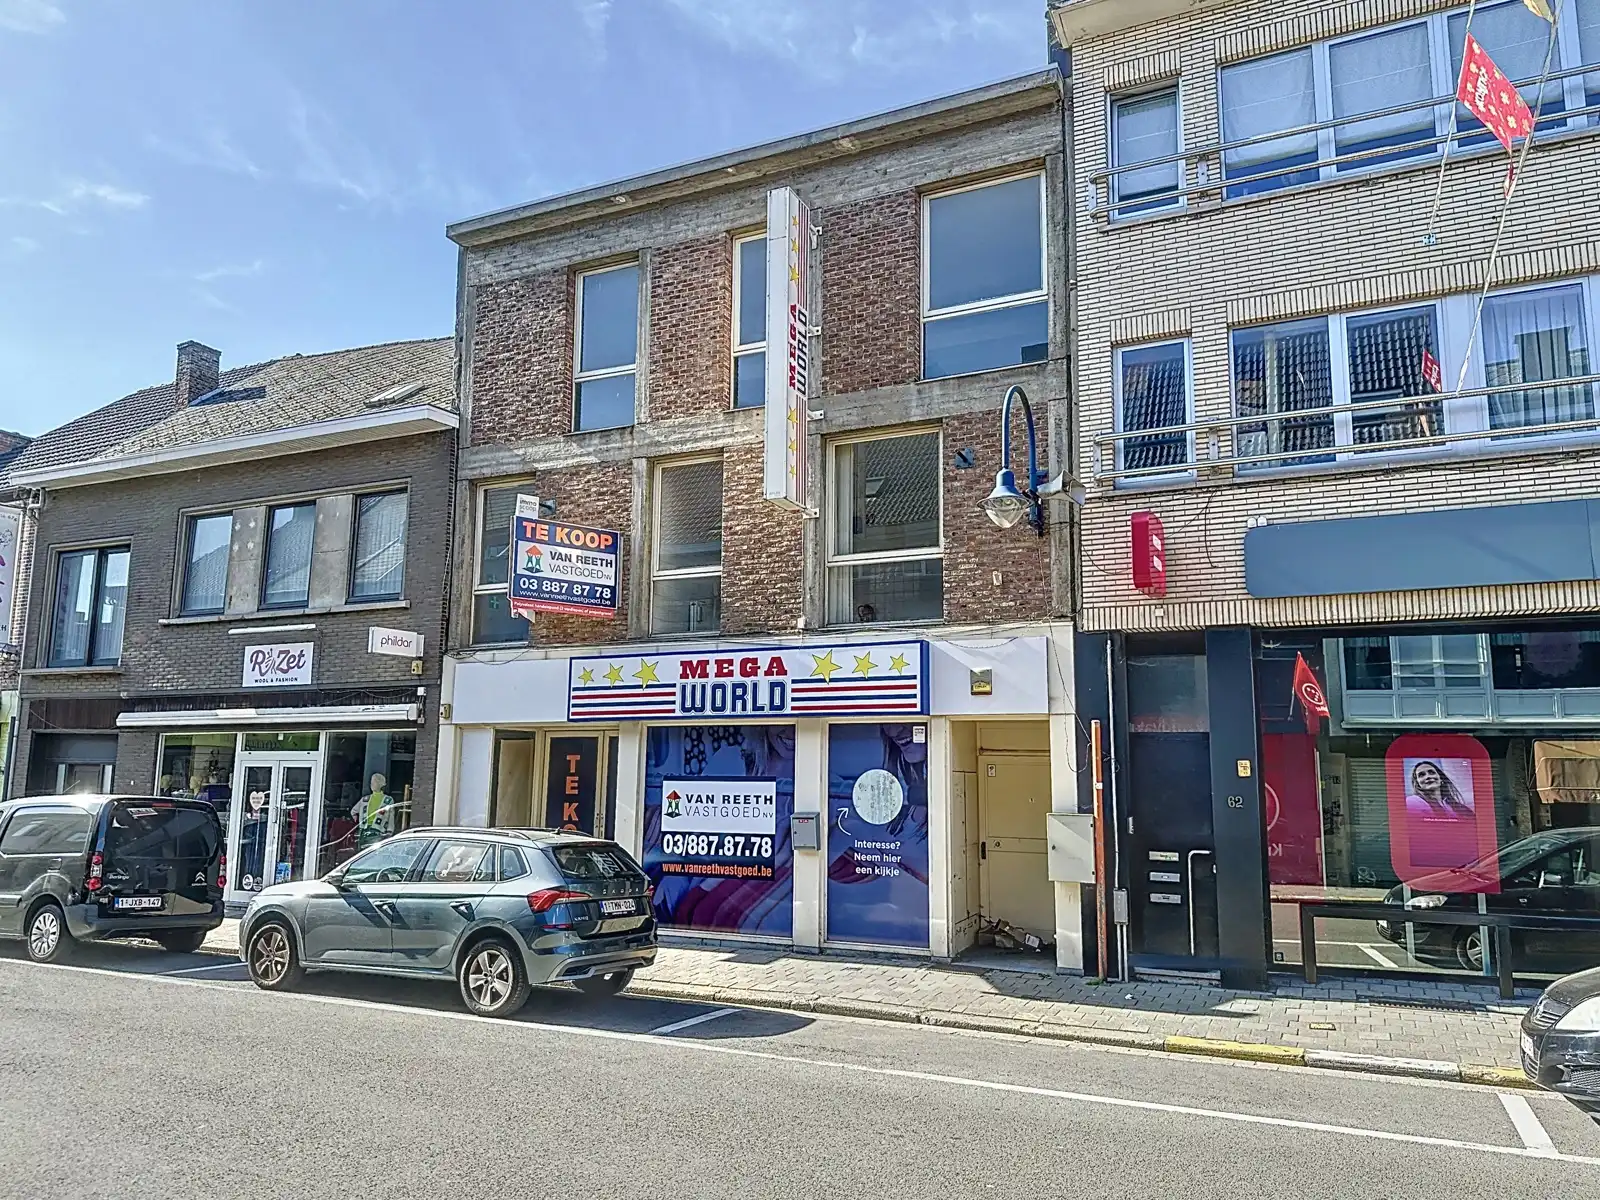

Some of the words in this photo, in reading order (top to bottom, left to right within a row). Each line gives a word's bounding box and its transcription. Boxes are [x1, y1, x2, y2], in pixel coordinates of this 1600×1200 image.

[797, 309, 807, 395] WORLD
[523, 522, 548, 540] TE
[556, 527, 612, 548] KOOP
[549, 551, 572, 563] VAN
[576, 554, 613, 568] REETH
[549, 563, 604, 579] VASTGOED
[519, 578, 538, 590] 03
[542, 580, 568, 593] 887
[573, 584, 590, 596] 87
[594, 586, 611, 599] 78
[519, 590, 611, 606] www.vanreethvastgoed.be
[380, 635, 412, 648] phildar
[680, 656, 788, 680] MEGA
[679, 680, 788, 714] WORLD
[685, 794, 715, 804] VAN
[722, 795, 773, 806] REETH
[1228, 796, 1243, 807] 62
[684, 805, 761, 818] VASTGOED
[662, 833, 773, 858] 03/887.87.78
[854, 839, 901, 850] Interesse?
[854, 852, 881, 862] Neem
[883, 853, 902, 863] hier
[662, 863, 772, 878] www.vanreethvastgoed.be
[855, 866, 873, 875] een
[874, 866, 900, 878] kijkje
